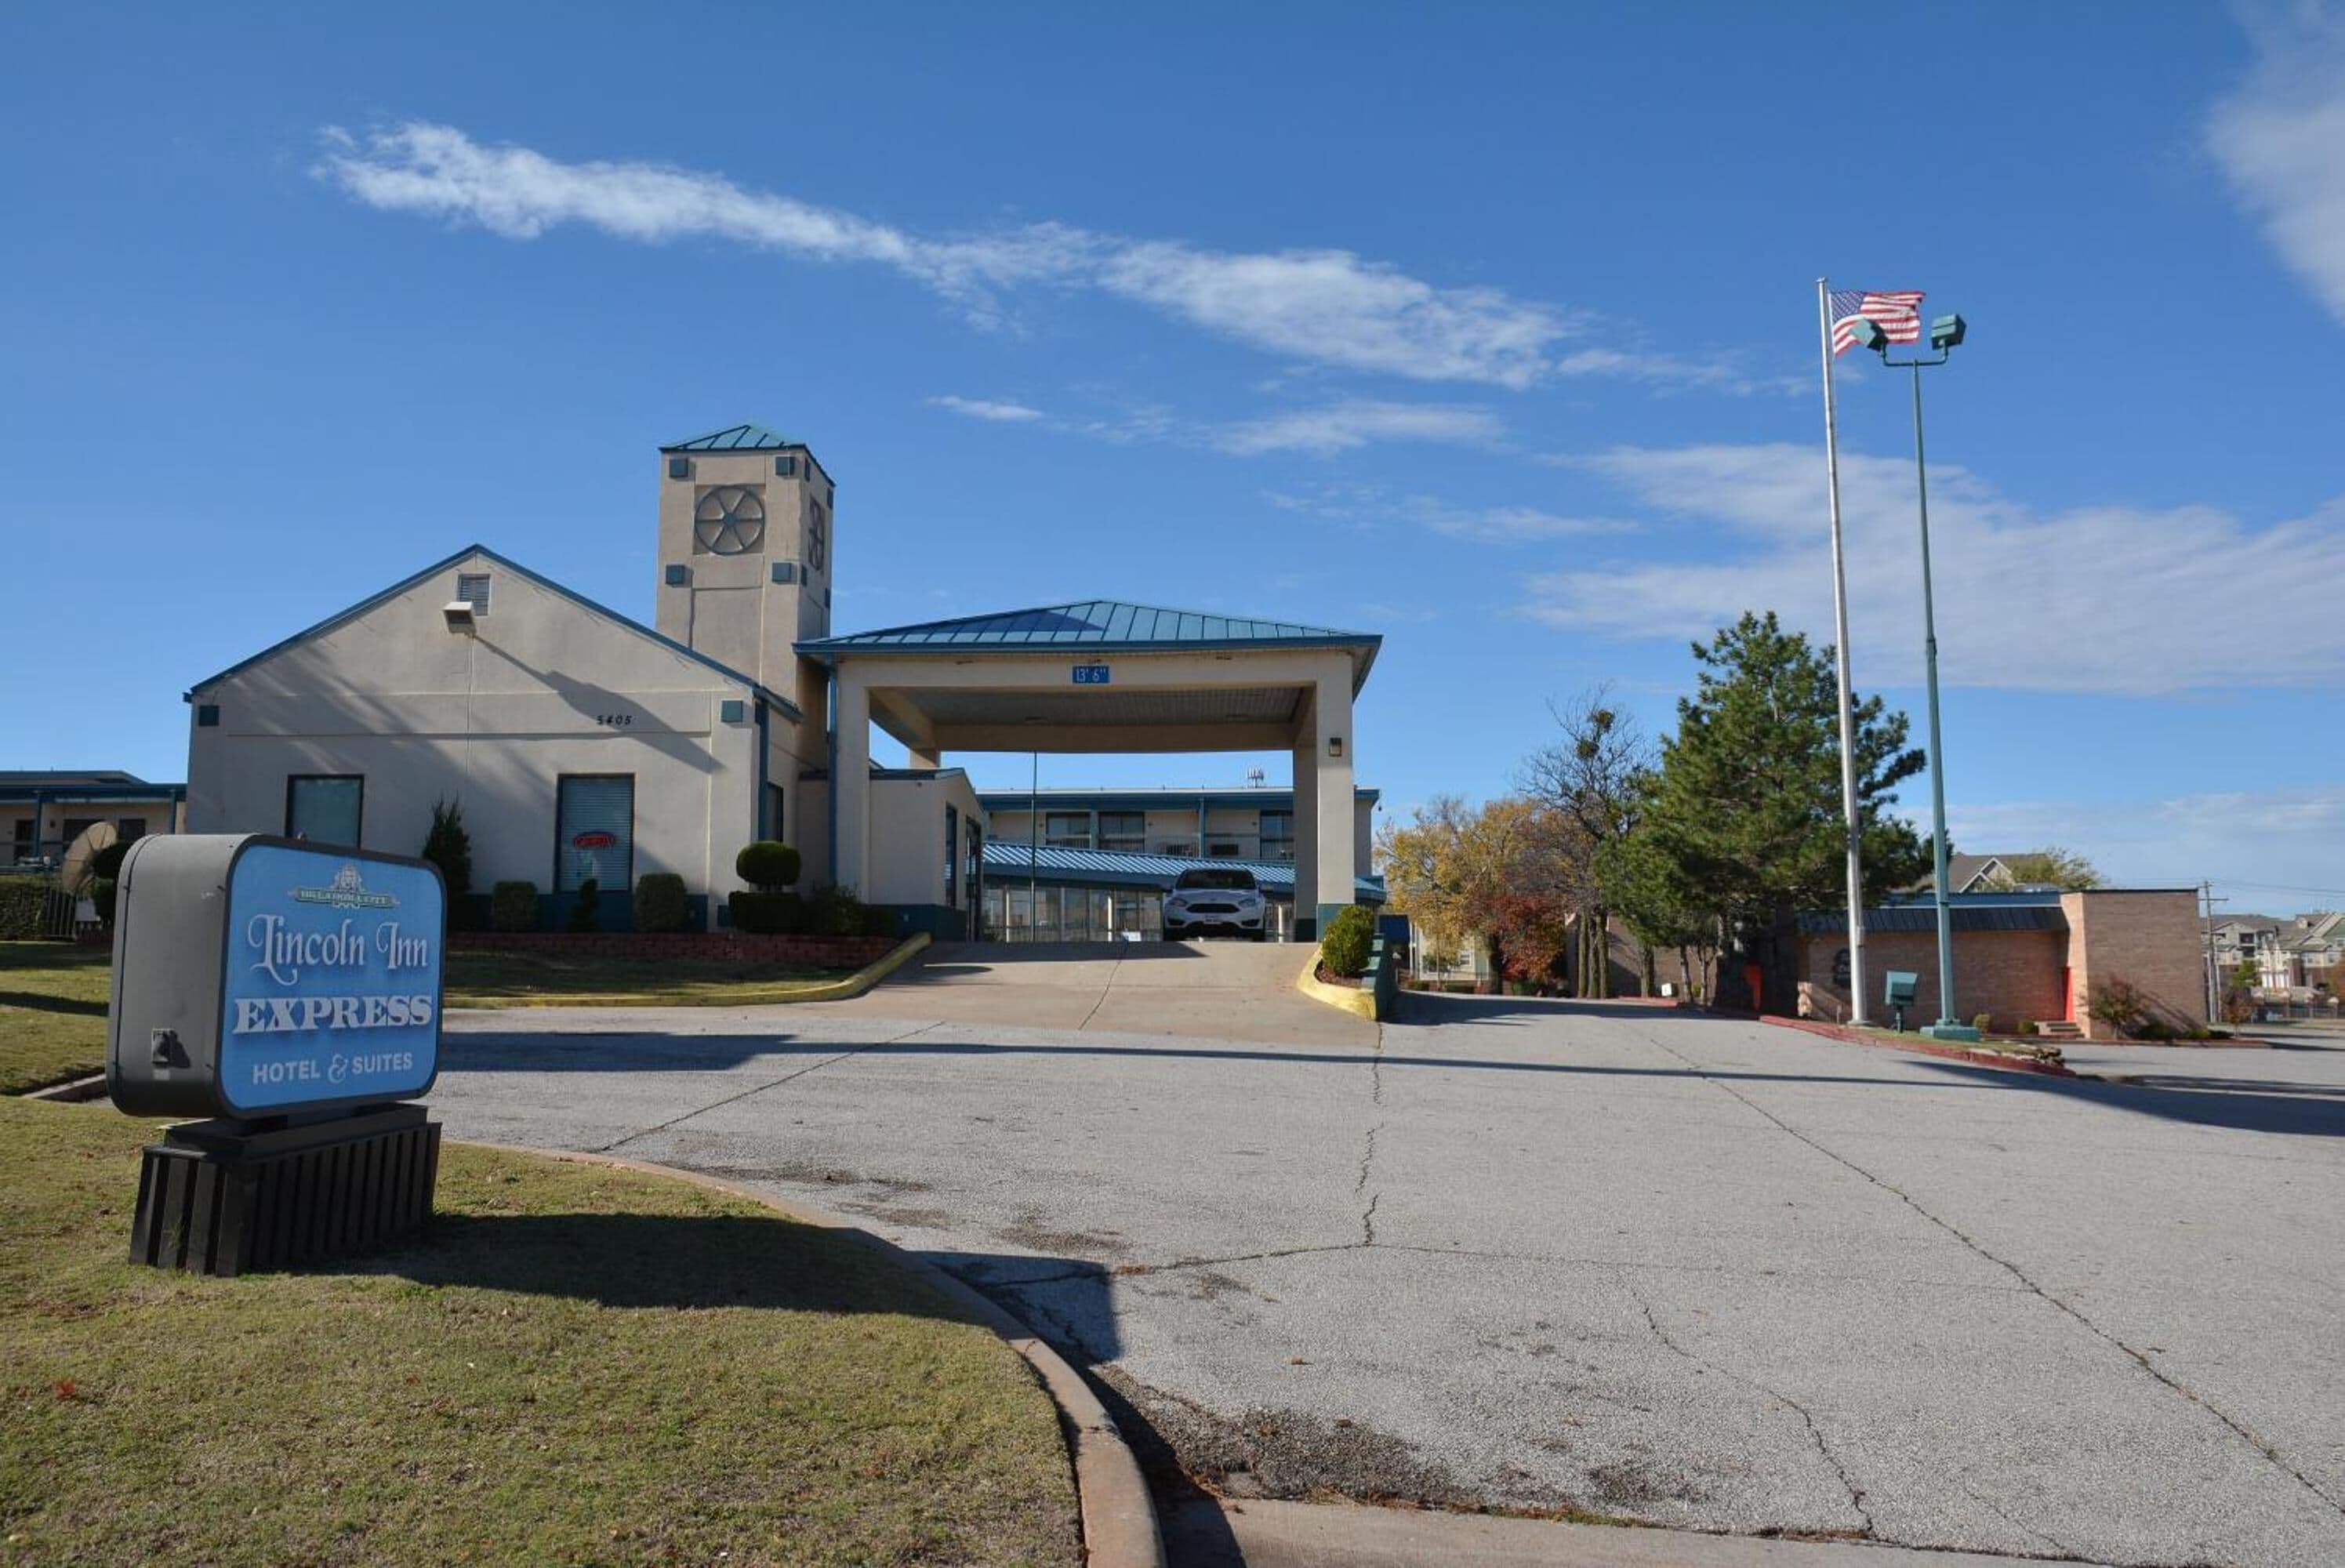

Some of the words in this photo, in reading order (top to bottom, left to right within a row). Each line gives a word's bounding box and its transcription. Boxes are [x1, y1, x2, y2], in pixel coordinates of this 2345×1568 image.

[248, 914, 365, 985] Lincoln
[376, 922, 428, 970] Inn
[232, 995, 432, 1034] EXPRESS
[252, 1061, 321, 1085] HOTEL
[328, 1054, 349, 1084] &
[351, 1053, 413, 1076] SUITES
